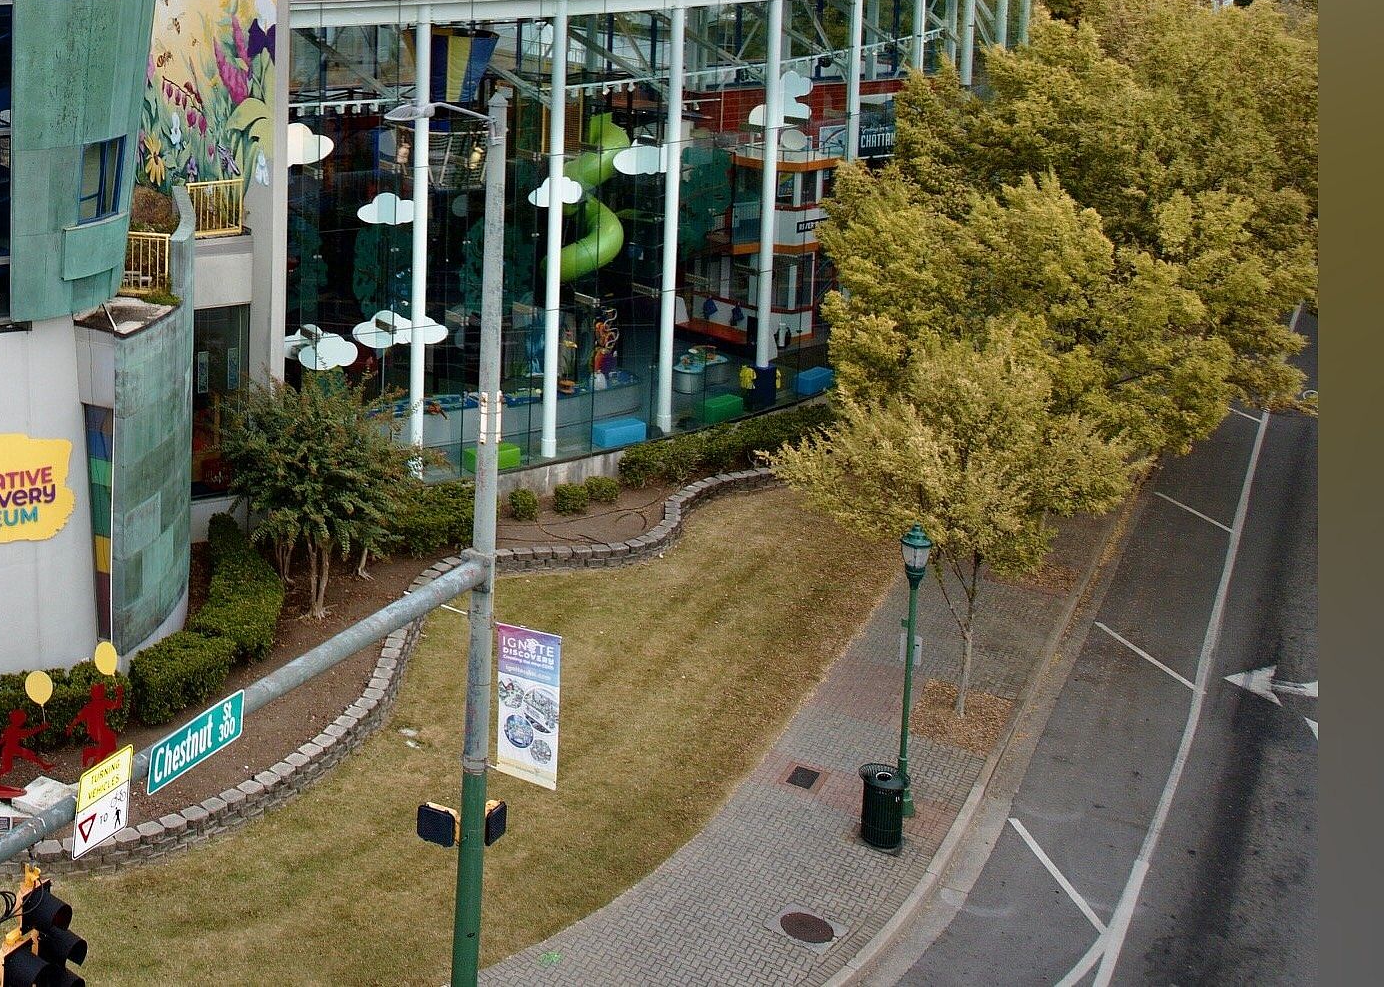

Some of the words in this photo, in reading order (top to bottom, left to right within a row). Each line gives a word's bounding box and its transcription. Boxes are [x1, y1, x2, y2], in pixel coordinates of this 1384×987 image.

[503, 647, 554, 664] DISCOVERY
[154, 715, 213, 783] Chestnut
[223, 701, 232, 721] St
[218, 717, 236, 742] 300
[91, 759, 120, 785] TURNING
[88, 774, 120, 800] VEHICLES
[100, 812, 109, 824] TO
